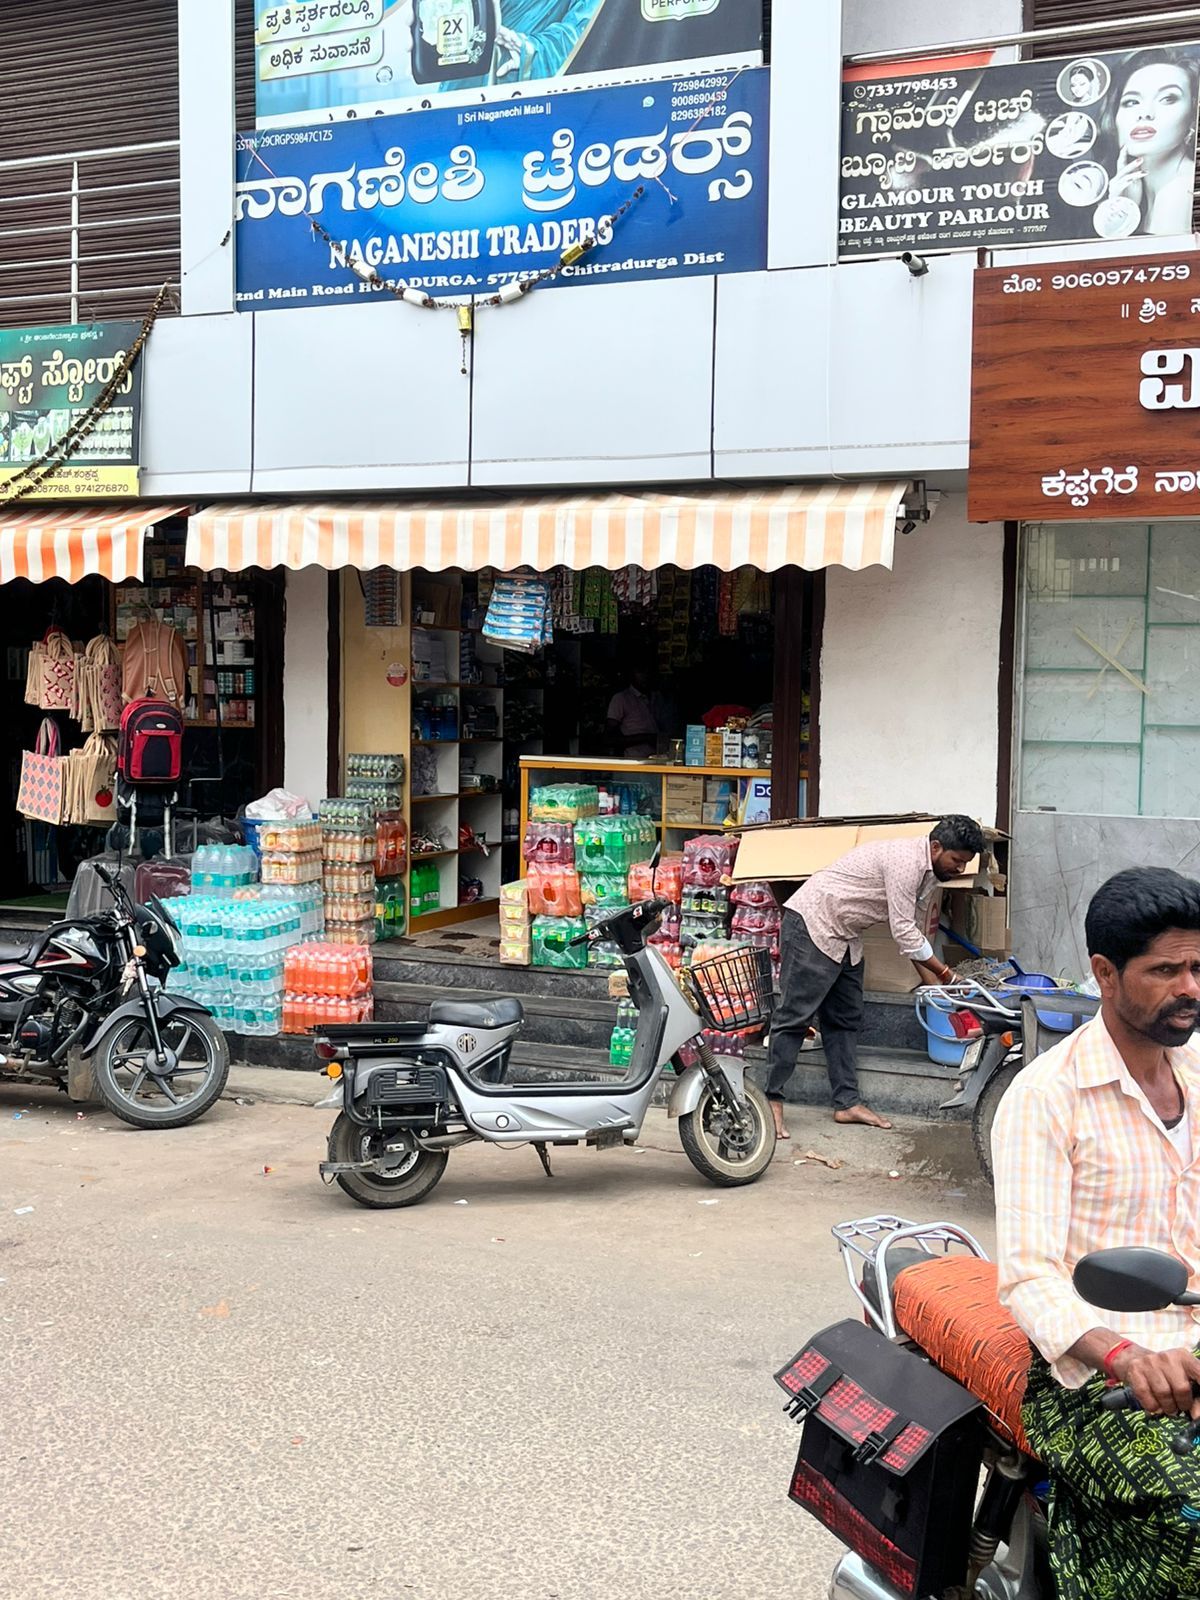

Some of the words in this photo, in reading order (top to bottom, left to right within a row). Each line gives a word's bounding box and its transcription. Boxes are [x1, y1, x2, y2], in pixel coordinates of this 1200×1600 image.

[266, 8, 292, 34] ಪ್ರತಿ
[443, 18, 464, 36] 2X
[270, 47, 303, 70] ಅಧಿಕ
[310, 36, 371, 62] ಸುವಾಸನೆ
[672, 76, 728, 93] 7259842992
[866, 77, 958, 98] 7337798453
[464, 112, 477, 123] Sri
[478, 107, 522, 122] Naganechi
[523, 104, 545, 115] Mata
[973, 89, 1033, 123] ಟಚ್
[235, 145, 486, 221] ನಾಗಣೇಶಿ
[841, 150, 917, 190] ಬ್ಯೂಟಿ
[841, 187, 956, 210] GLAMOUR
[960, 180, 1045, 201] TOUCH
[839, 211, 934, 234] BEAUTY
[937, 203, 1050, 227] PARLOUR
[329, 229, 480, 270] NAGANESHI
[486, 215, 614, 257] TRADERS
[235, 290, 264, 302] 2nd
[268, 287, 308, 300] Main
[312, 284, 354, 296] Road
[560, 256, 678, 278] Chitradurga
[683, 251, 725, 265] Dist
[1003, 273, 1042, 294] ಮೊ:
[1051, 265, 1191, 290] 9060974759
[1138, 298, 1167, 323] ಶ್ರೀ
[0, 354, 33, 405] ಫ್ಟ್
[75, 483, 129, 493] 9741276870
[1041, 465, 1139, 507] ಕಪ್ಪಗೆರೆ
[1154, 470, 1200, 493] ನಾ
